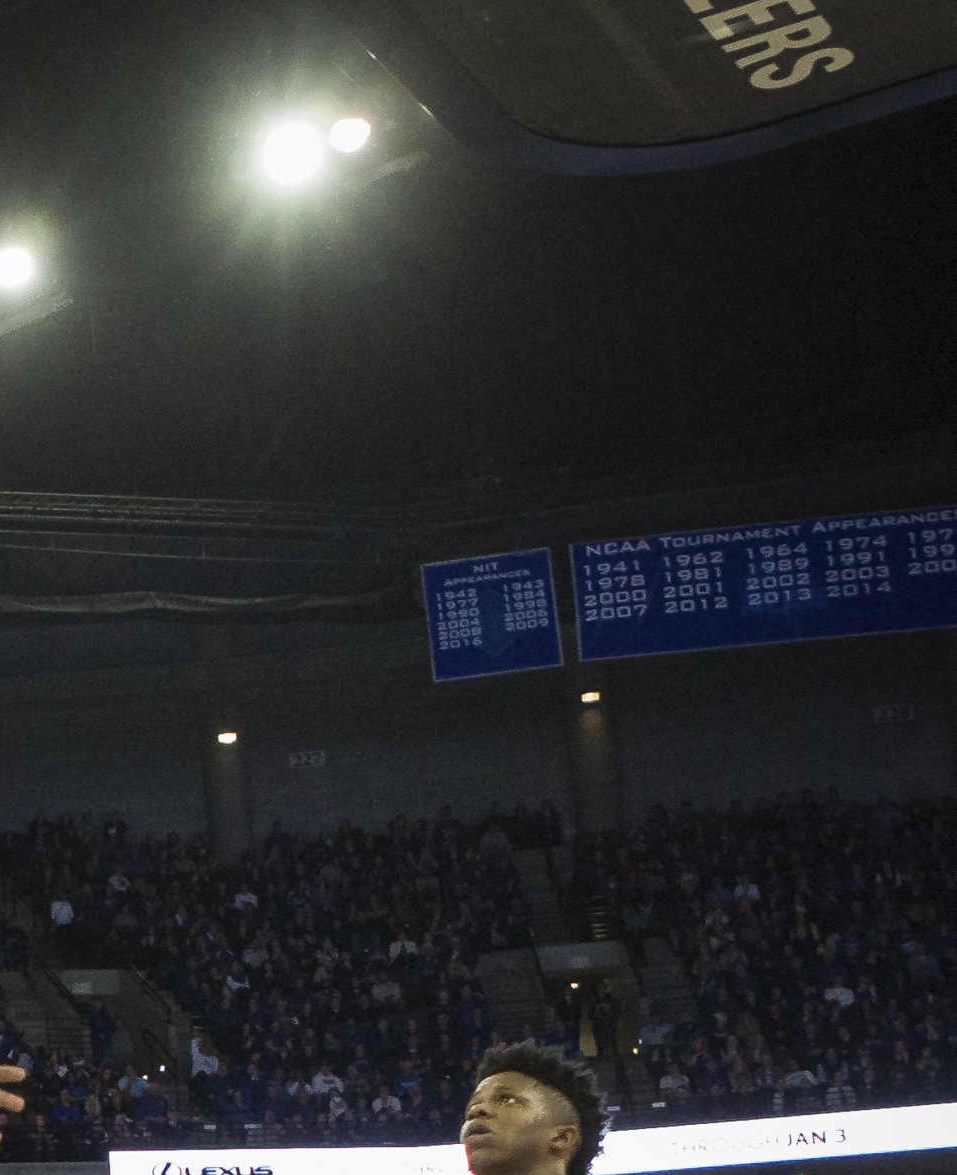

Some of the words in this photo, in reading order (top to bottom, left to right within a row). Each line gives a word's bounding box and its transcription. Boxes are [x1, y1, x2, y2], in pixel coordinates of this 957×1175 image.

[684, 0, 854, 89] ERS
[584, 560, 640, 576] 1941
[664, 551, 724, 568] 1962
[746, 543, 808, 560] 1964
[825, 535, 888, 552] 1974
[908, 528, 957, 545] 197
[585, 540, 650, 557] NCAA
[659, 526, 801, 548] TOURNAMENT
[812, 509, 957, 533] APPEARANCE
[473, 562, 500, 573] NIT
[584, 589, 647, 607] 2000
[663, 581, 723, 598] 2001
[746, 572, 810, 590] 2002
[825, 565, 890, 583] 2003
[908, 560, 957, 576] 200
[585, 574, 645, 591] 1978
[664, 566, 723, 583] 1981
[747, 557, 809, 575] 1989
[826, 550, 885, 567] 1991
[908, 544, 956, 559] 199
[585, 604, 647, 622] 2007
[665, 596, 728, 614] 2012
[748, 588, 811, 606] 2013
[826, 581, 891, 598] 2014
[786, 1129, 827, 1147] JAN
[836, 1127, 847, 1143] 3
